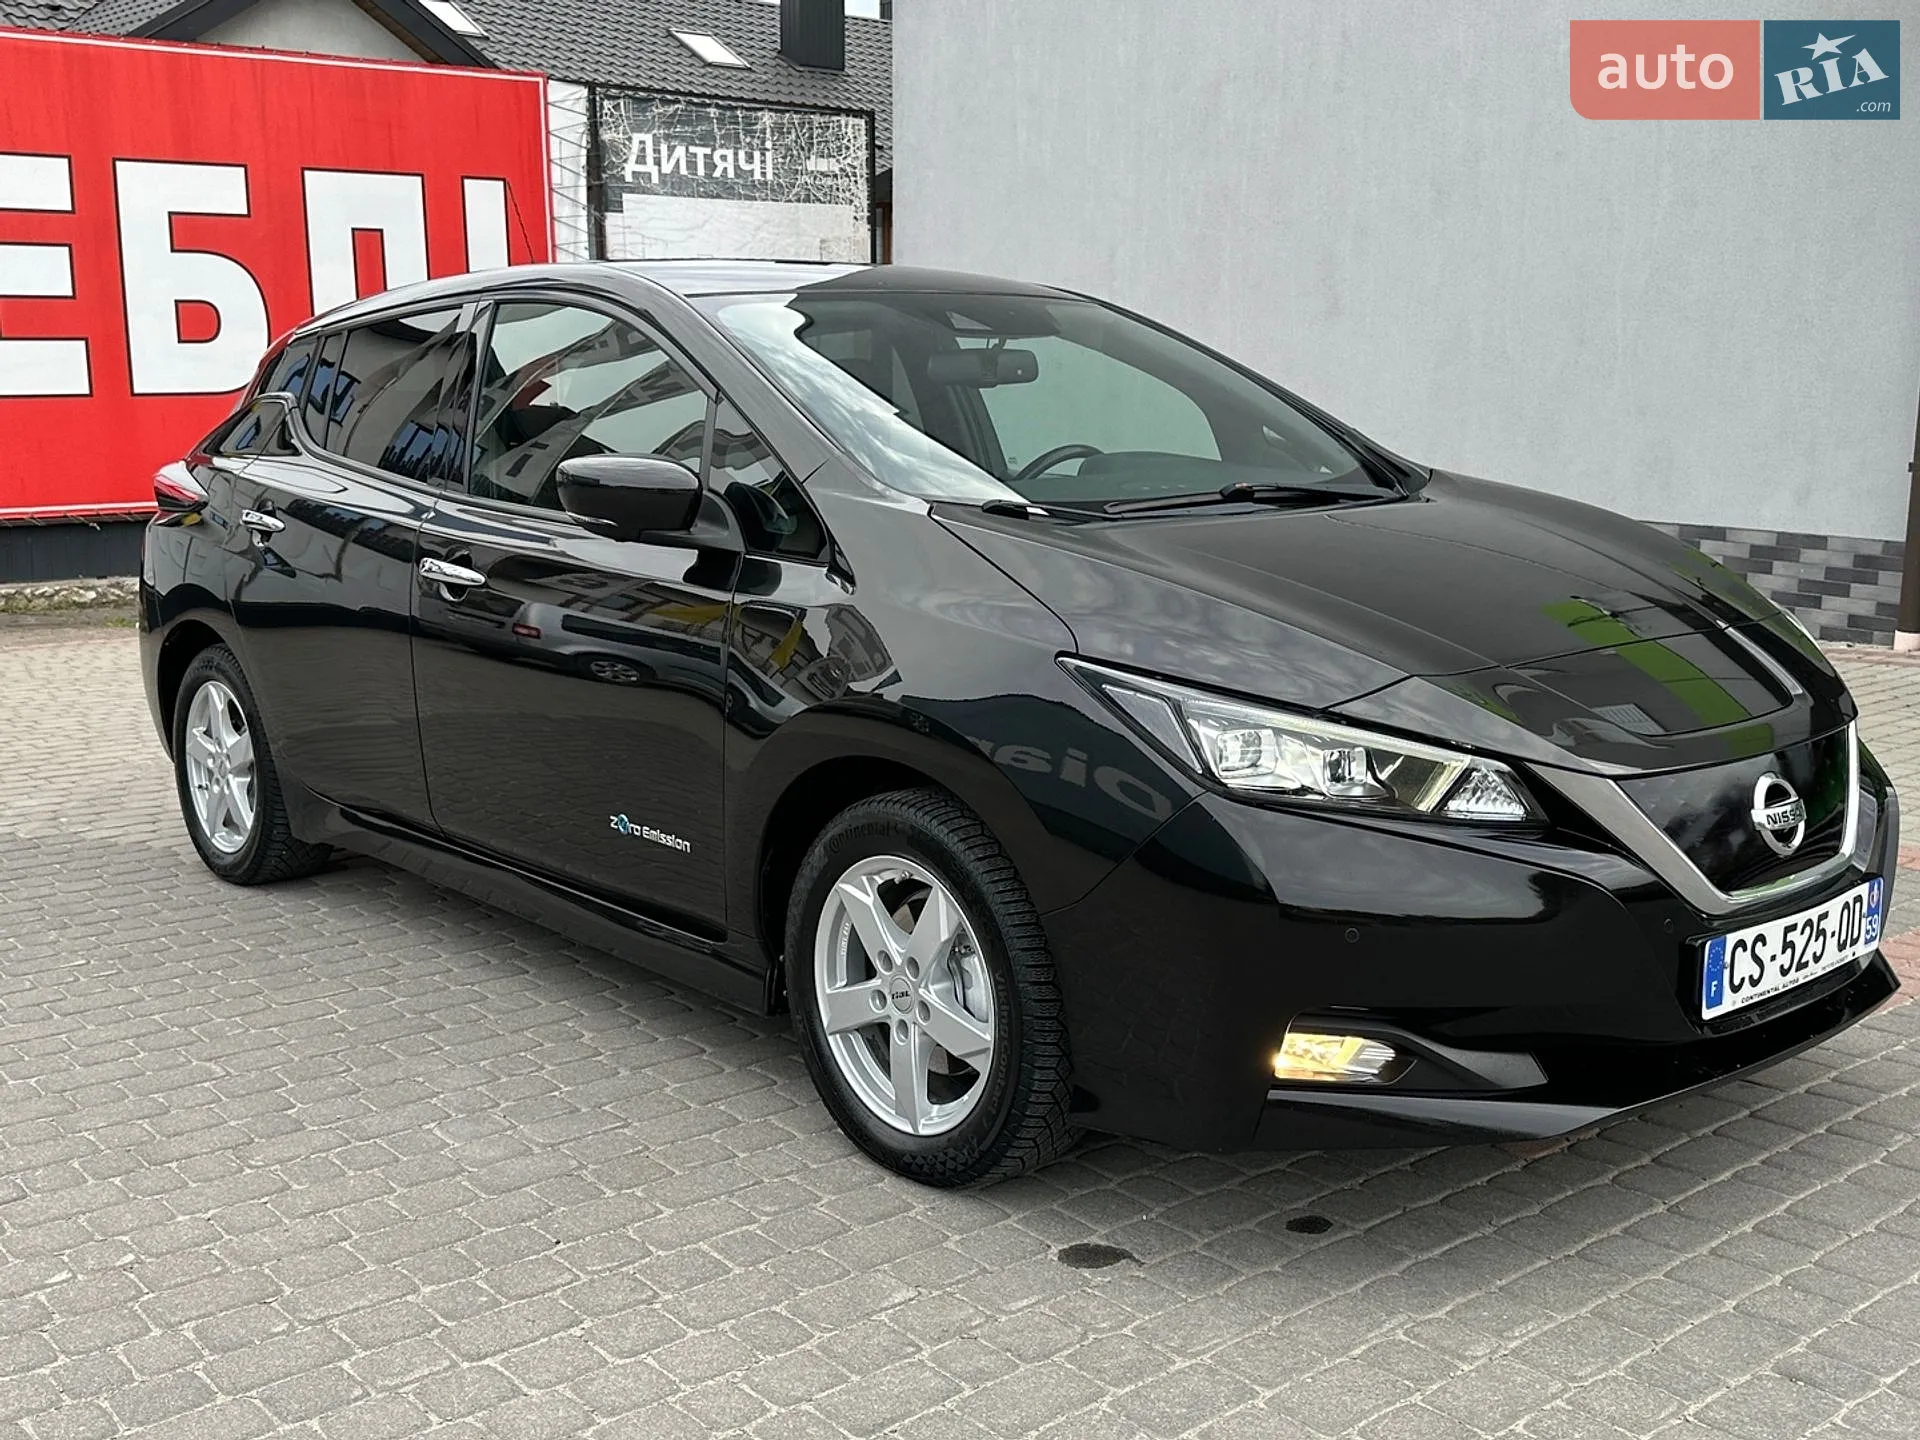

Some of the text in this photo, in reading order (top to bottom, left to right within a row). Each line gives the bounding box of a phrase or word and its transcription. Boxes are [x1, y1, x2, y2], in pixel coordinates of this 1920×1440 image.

[624, 133, 774, 184] Дитячі
[1766, 806, 1803, 825] NISSA
[642, 825, 692, 853] Emission
[1865, 914, 1879, 940] 59
[1711, 980, 1717, 998] F
[1741, 986, 1780, 1003] CONTINENTAL
